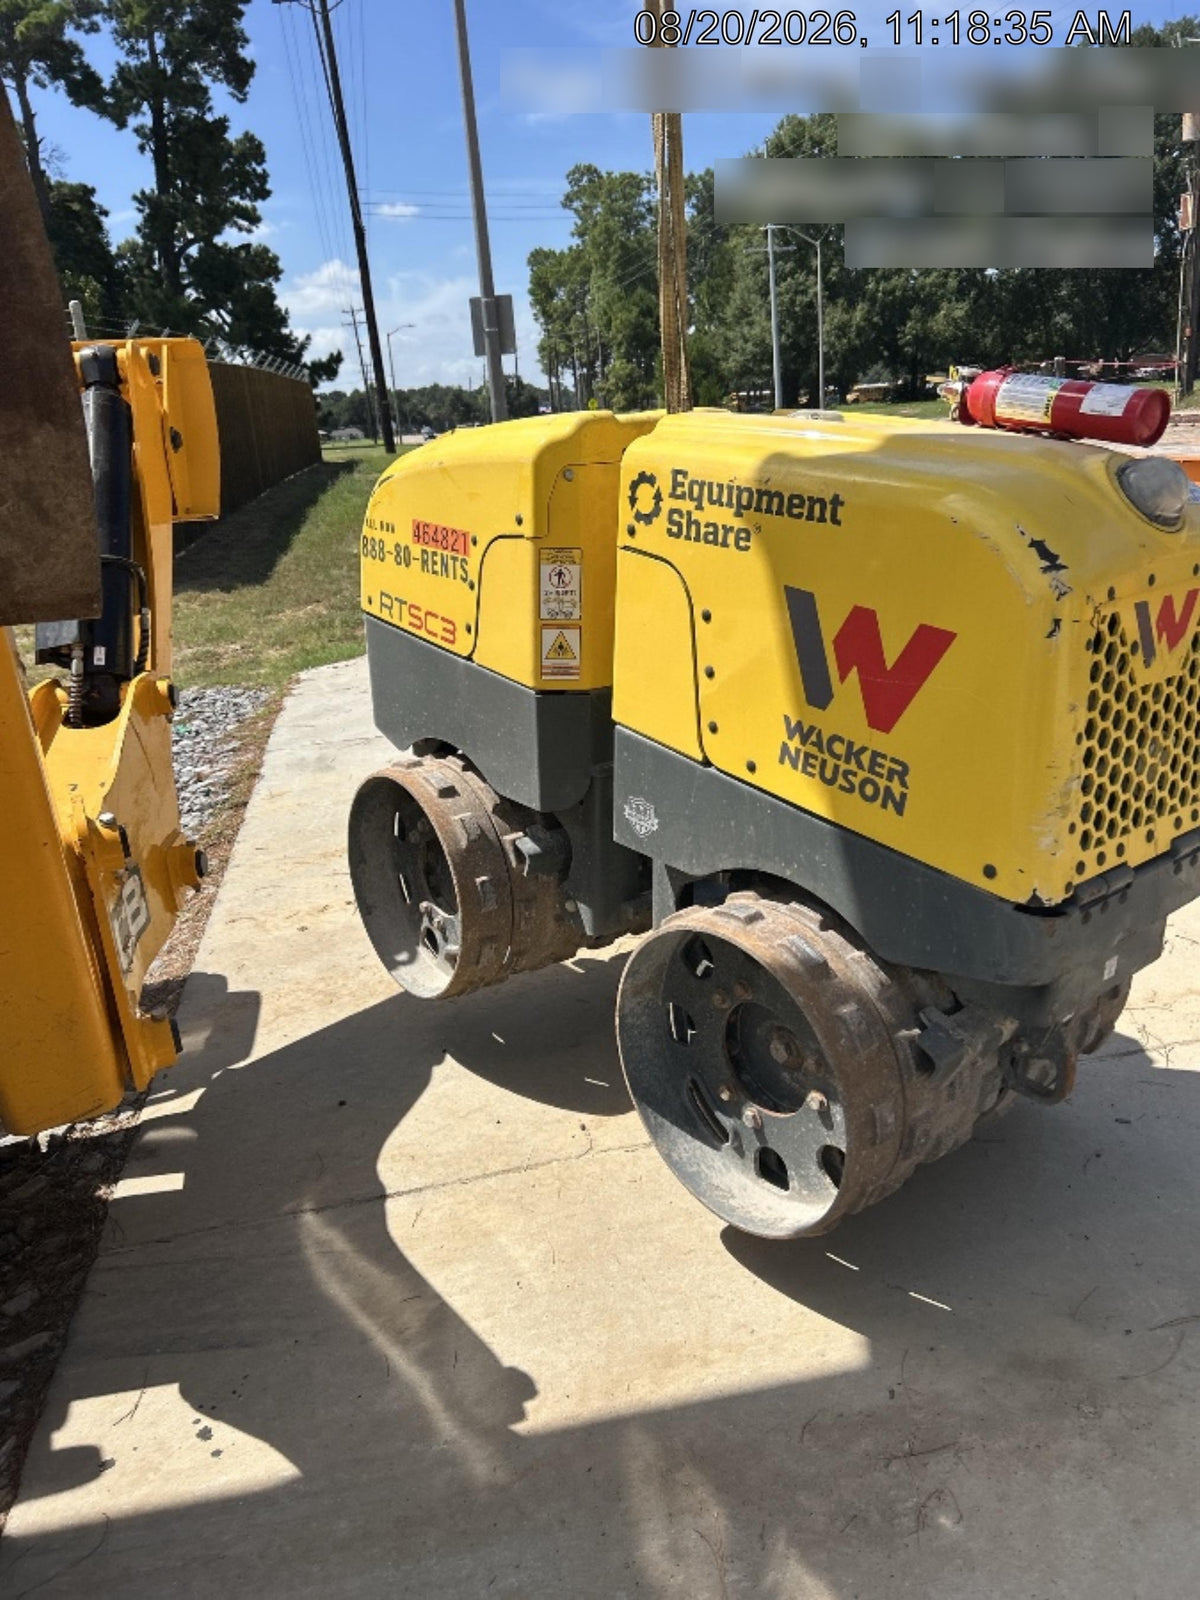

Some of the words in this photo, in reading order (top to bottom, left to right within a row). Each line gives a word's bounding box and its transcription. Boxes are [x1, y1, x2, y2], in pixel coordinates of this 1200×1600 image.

[668, 468, 845, 526] Equipment
[413, 521, 467, 555] 464821
[778, 740, 908, 817] NEUSON
[783, 713, 910, 790] WACKER
